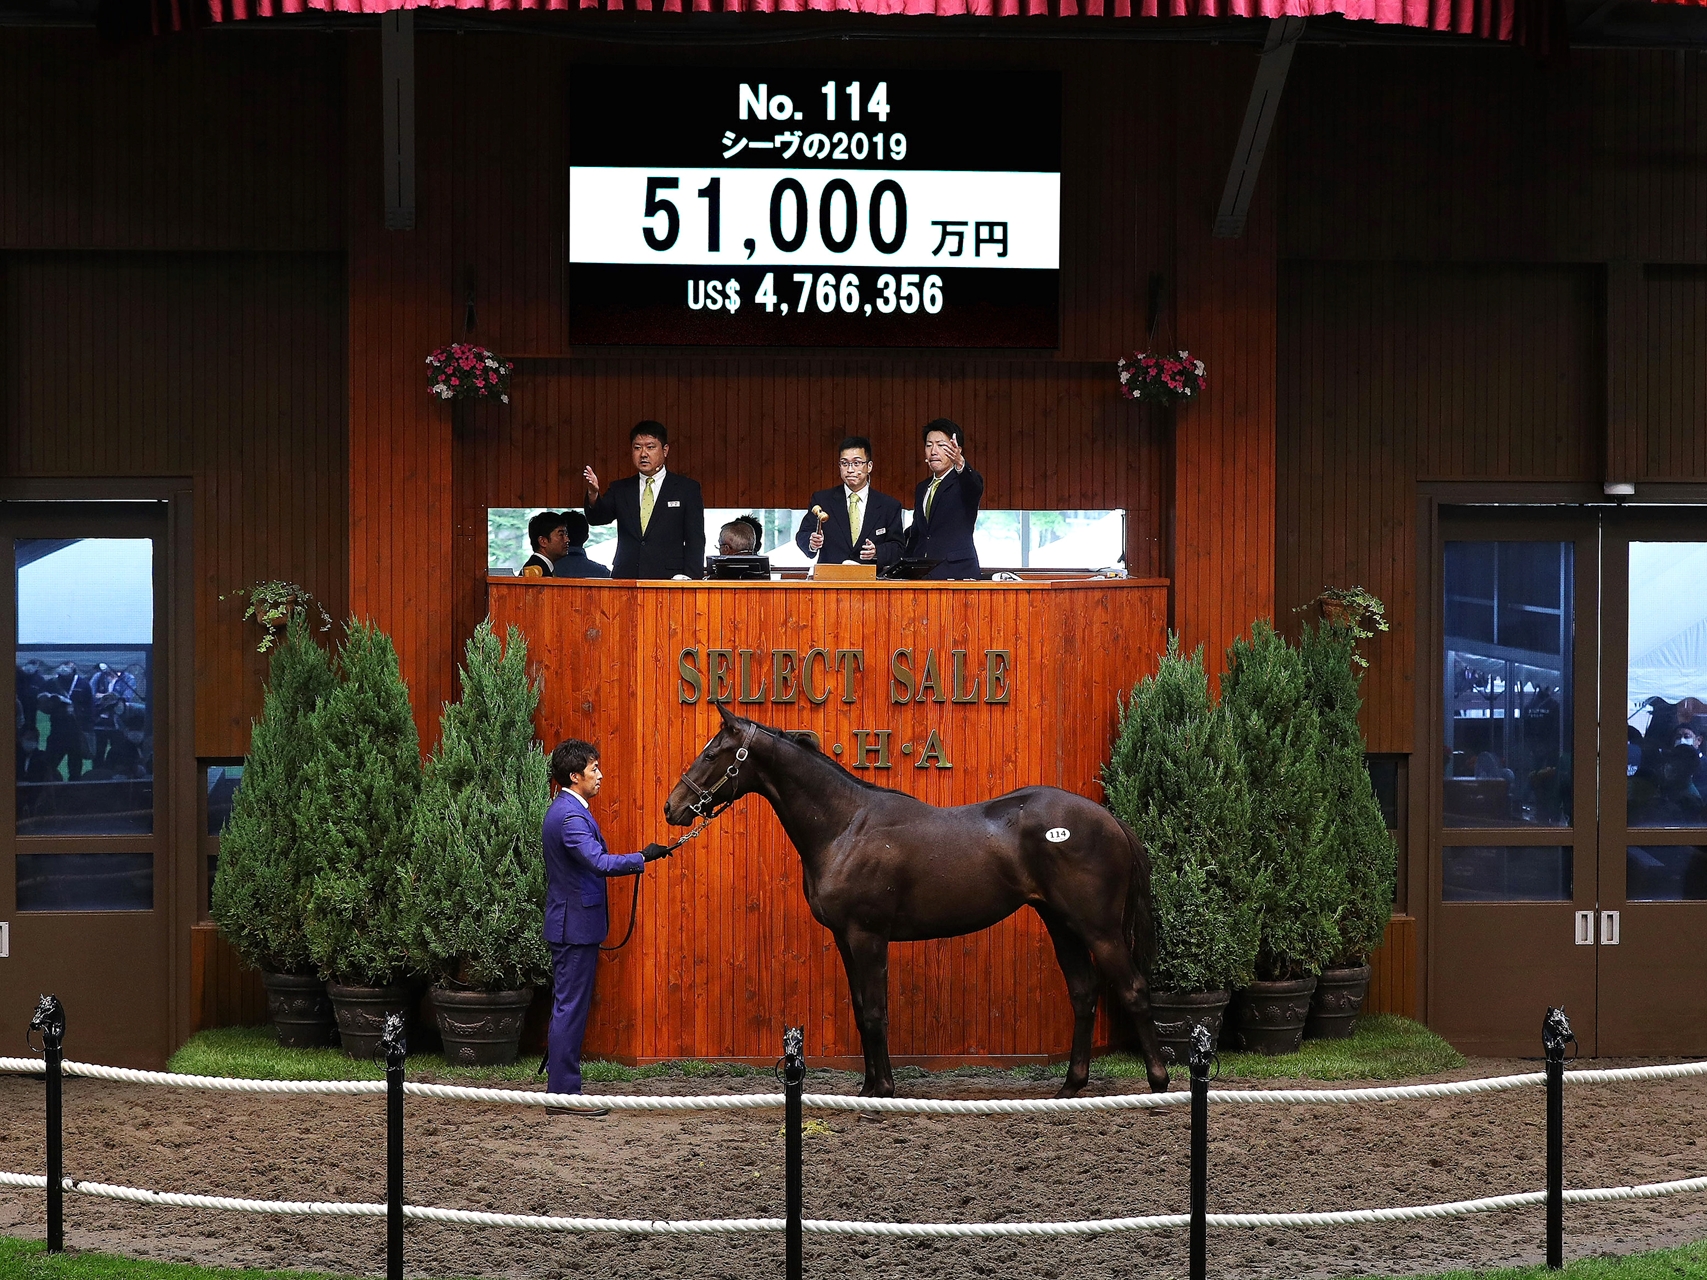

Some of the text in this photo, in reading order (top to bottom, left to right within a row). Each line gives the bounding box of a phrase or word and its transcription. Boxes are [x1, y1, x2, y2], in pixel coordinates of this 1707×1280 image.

[739, 80, 891, 122] No. 114
[721, 130, 908, 161] シーヴの2019
[642, 176, 1009, 260] 51,000 万円
[687, 272, 944, 317] US$ 4,766,356
[678, 647, 1010, 704] SELECT SALE
[1050, 830, 1067, 839] 114
